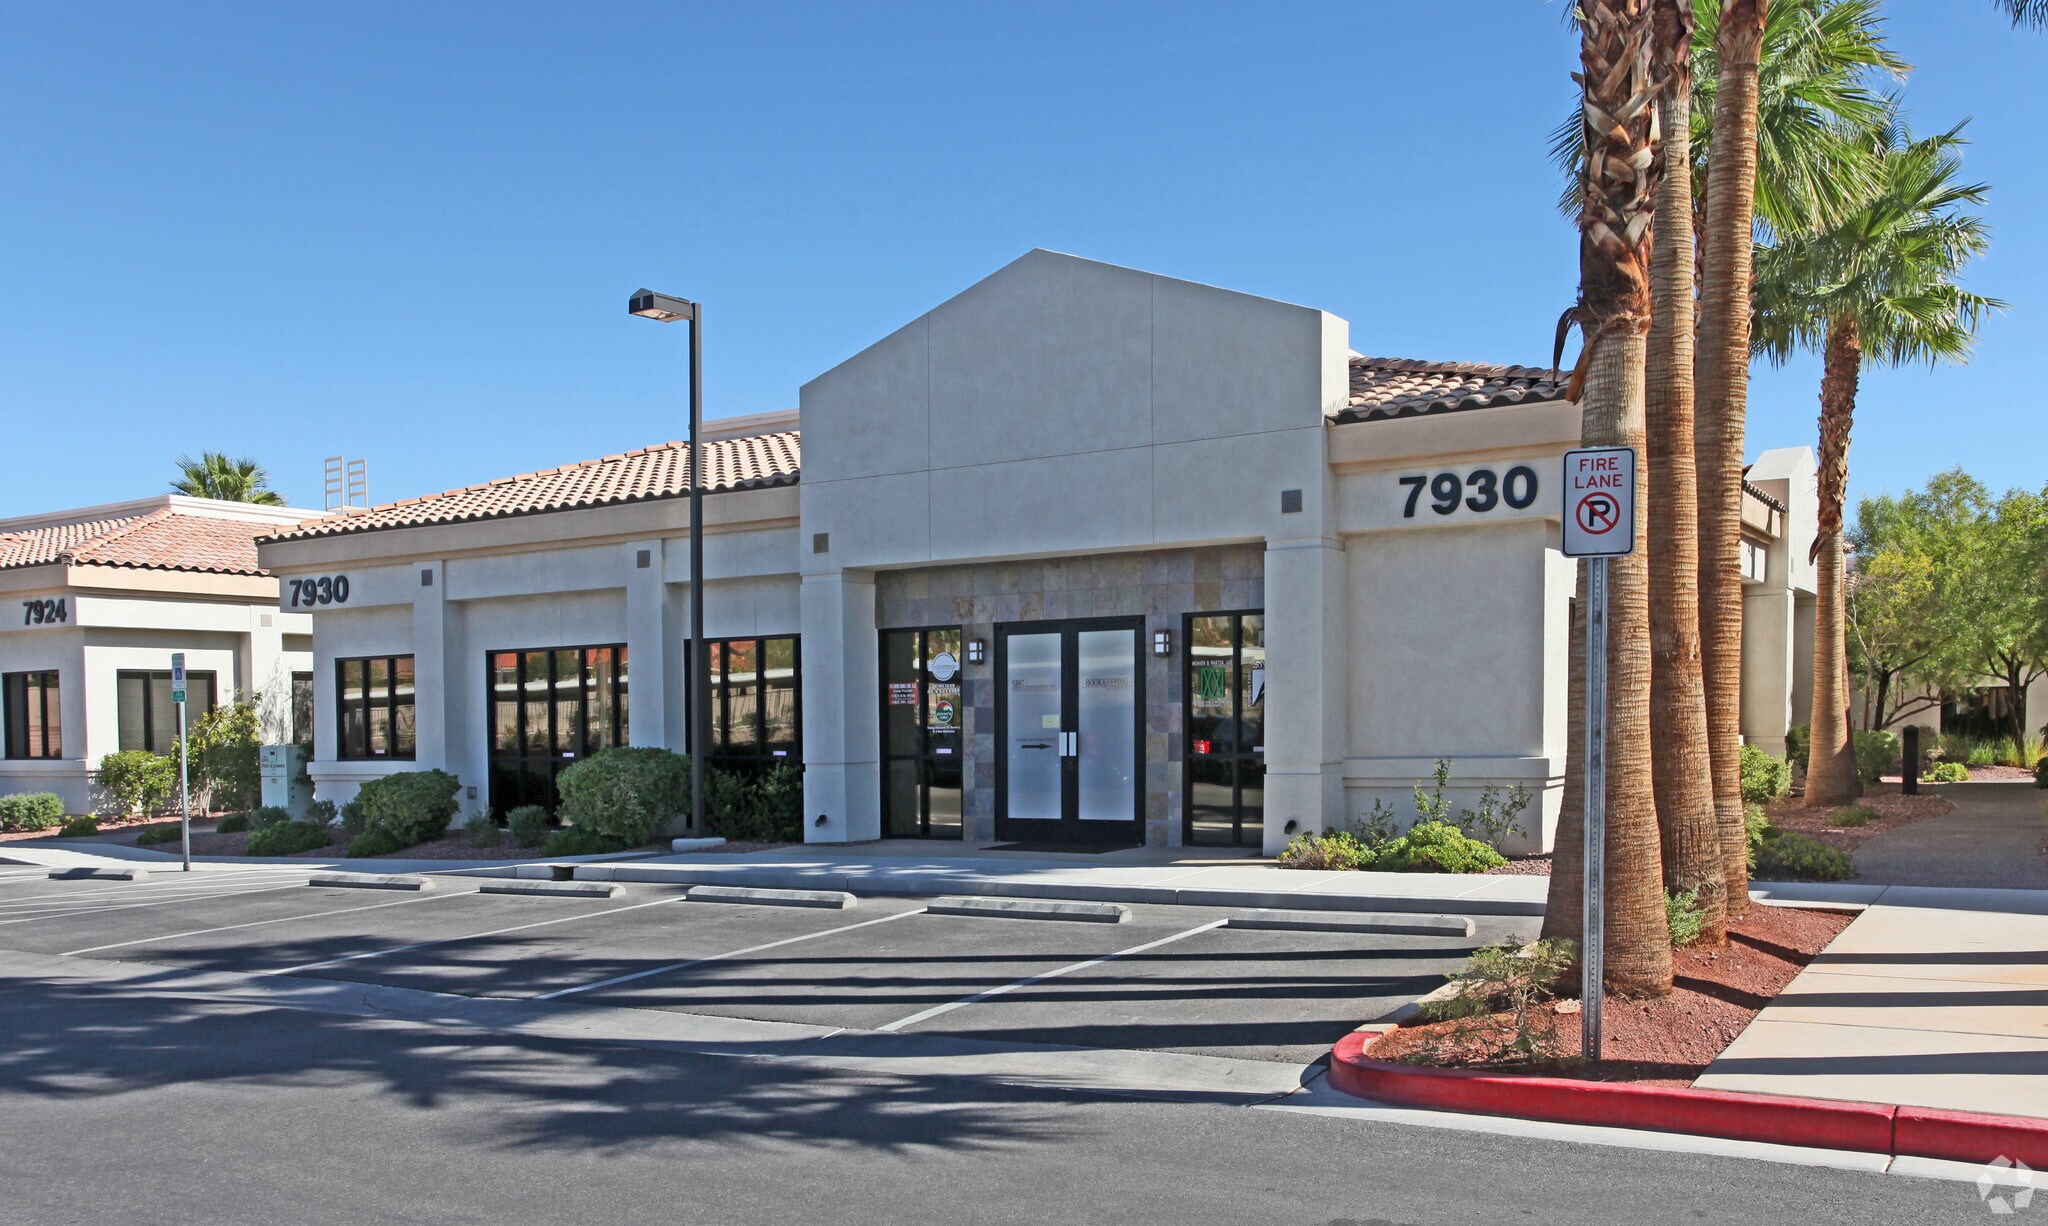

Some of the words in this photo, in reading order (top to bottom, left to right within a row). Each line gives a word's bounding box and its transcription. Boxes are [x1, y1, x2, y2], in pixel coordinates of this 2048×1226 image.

[1579, 457, 1619, 472] FIRE
[1399, 465, 1538, 518] 7930
[1574, 474, 1623, 489] LANE
[289, 575, 349, 607] 7930
[23, 599, 67, 625] 7924
[1085, 677, 1129, 688] BOOKKEEPING
